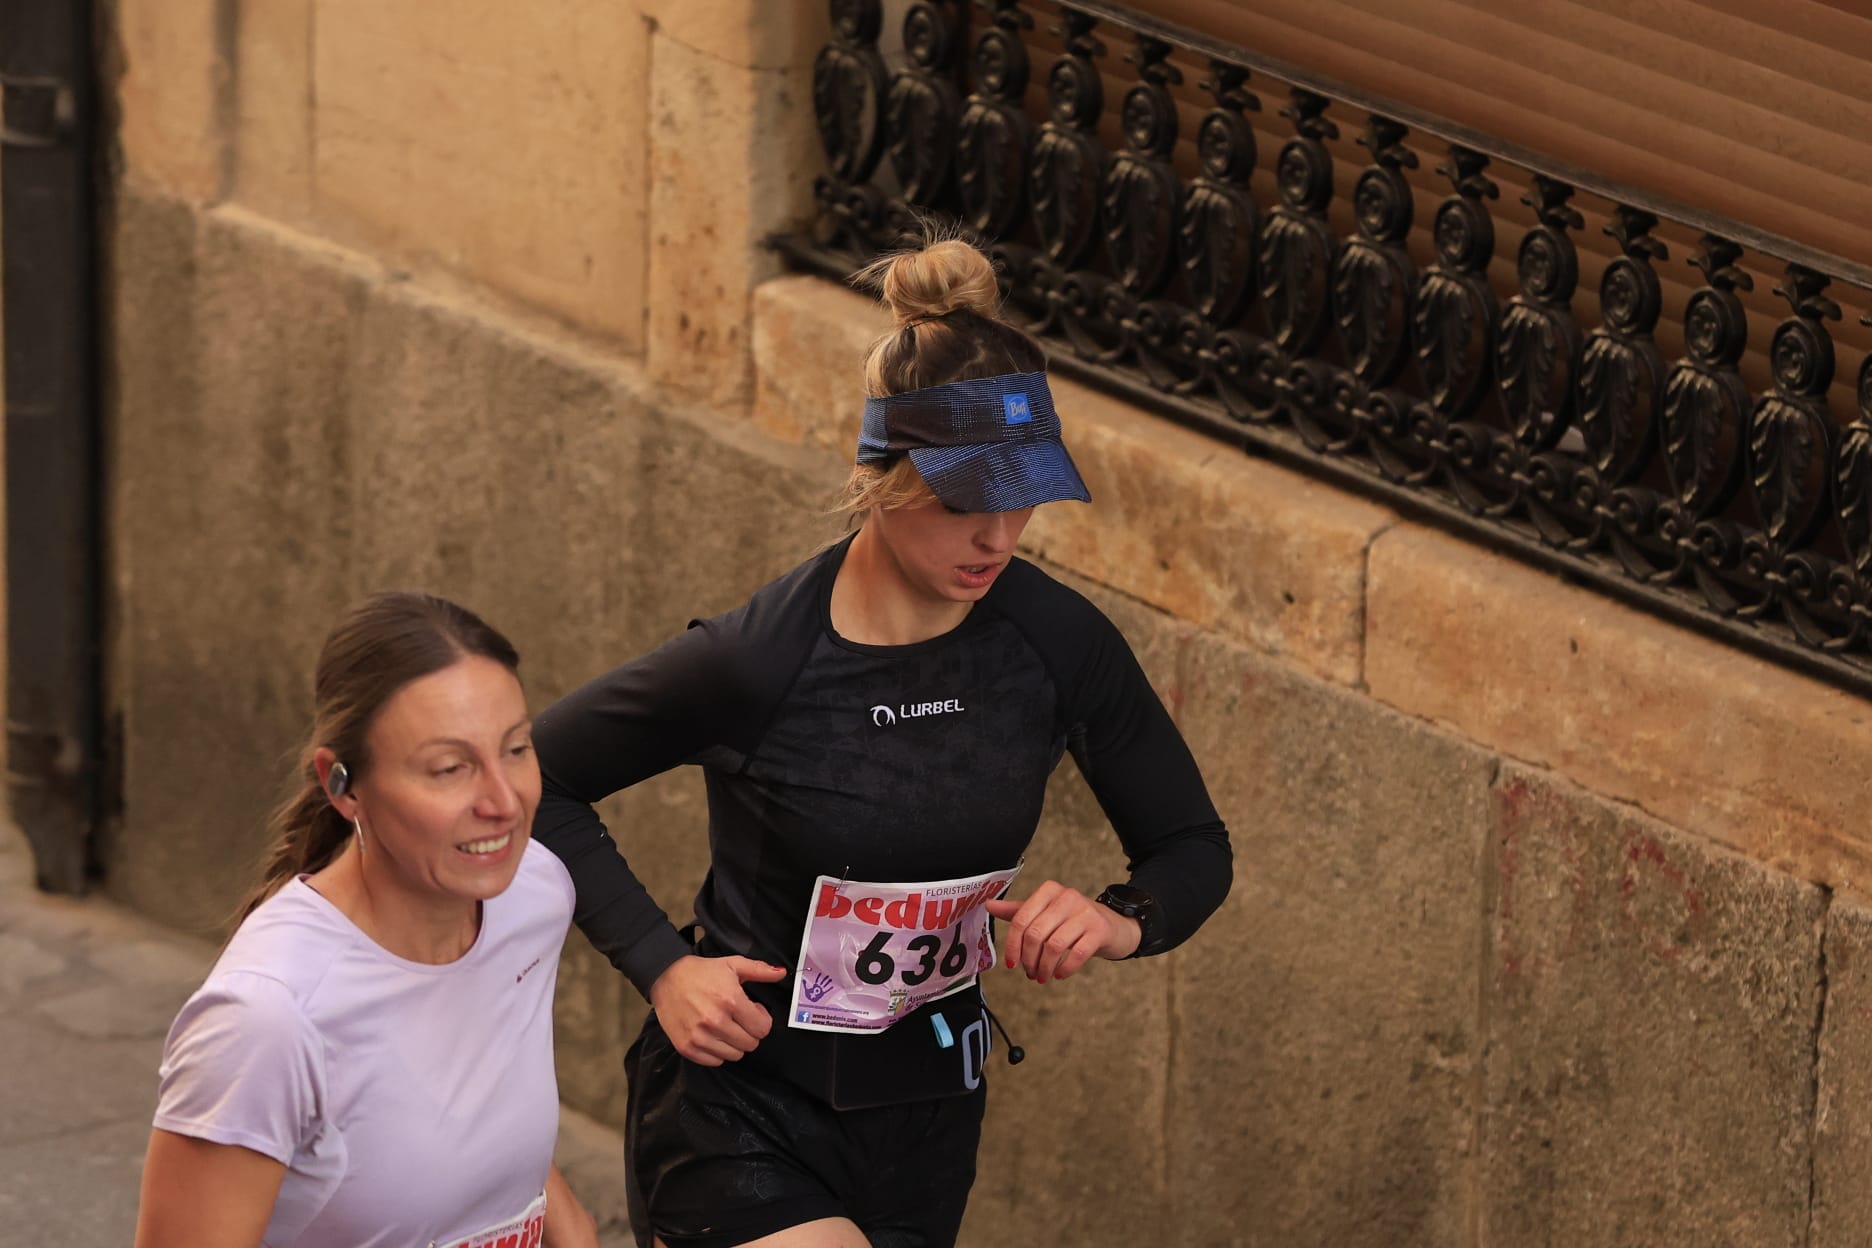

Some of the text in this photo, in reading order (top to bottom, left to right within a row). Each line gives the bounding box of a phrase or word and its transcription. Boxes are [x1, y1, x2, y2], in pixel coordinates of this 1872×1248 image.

[899, 698, 965, 719] LURBEL
[925, 881, 983, 897] FLORISTERÍAS
[854, 924, 967, 986] 636
